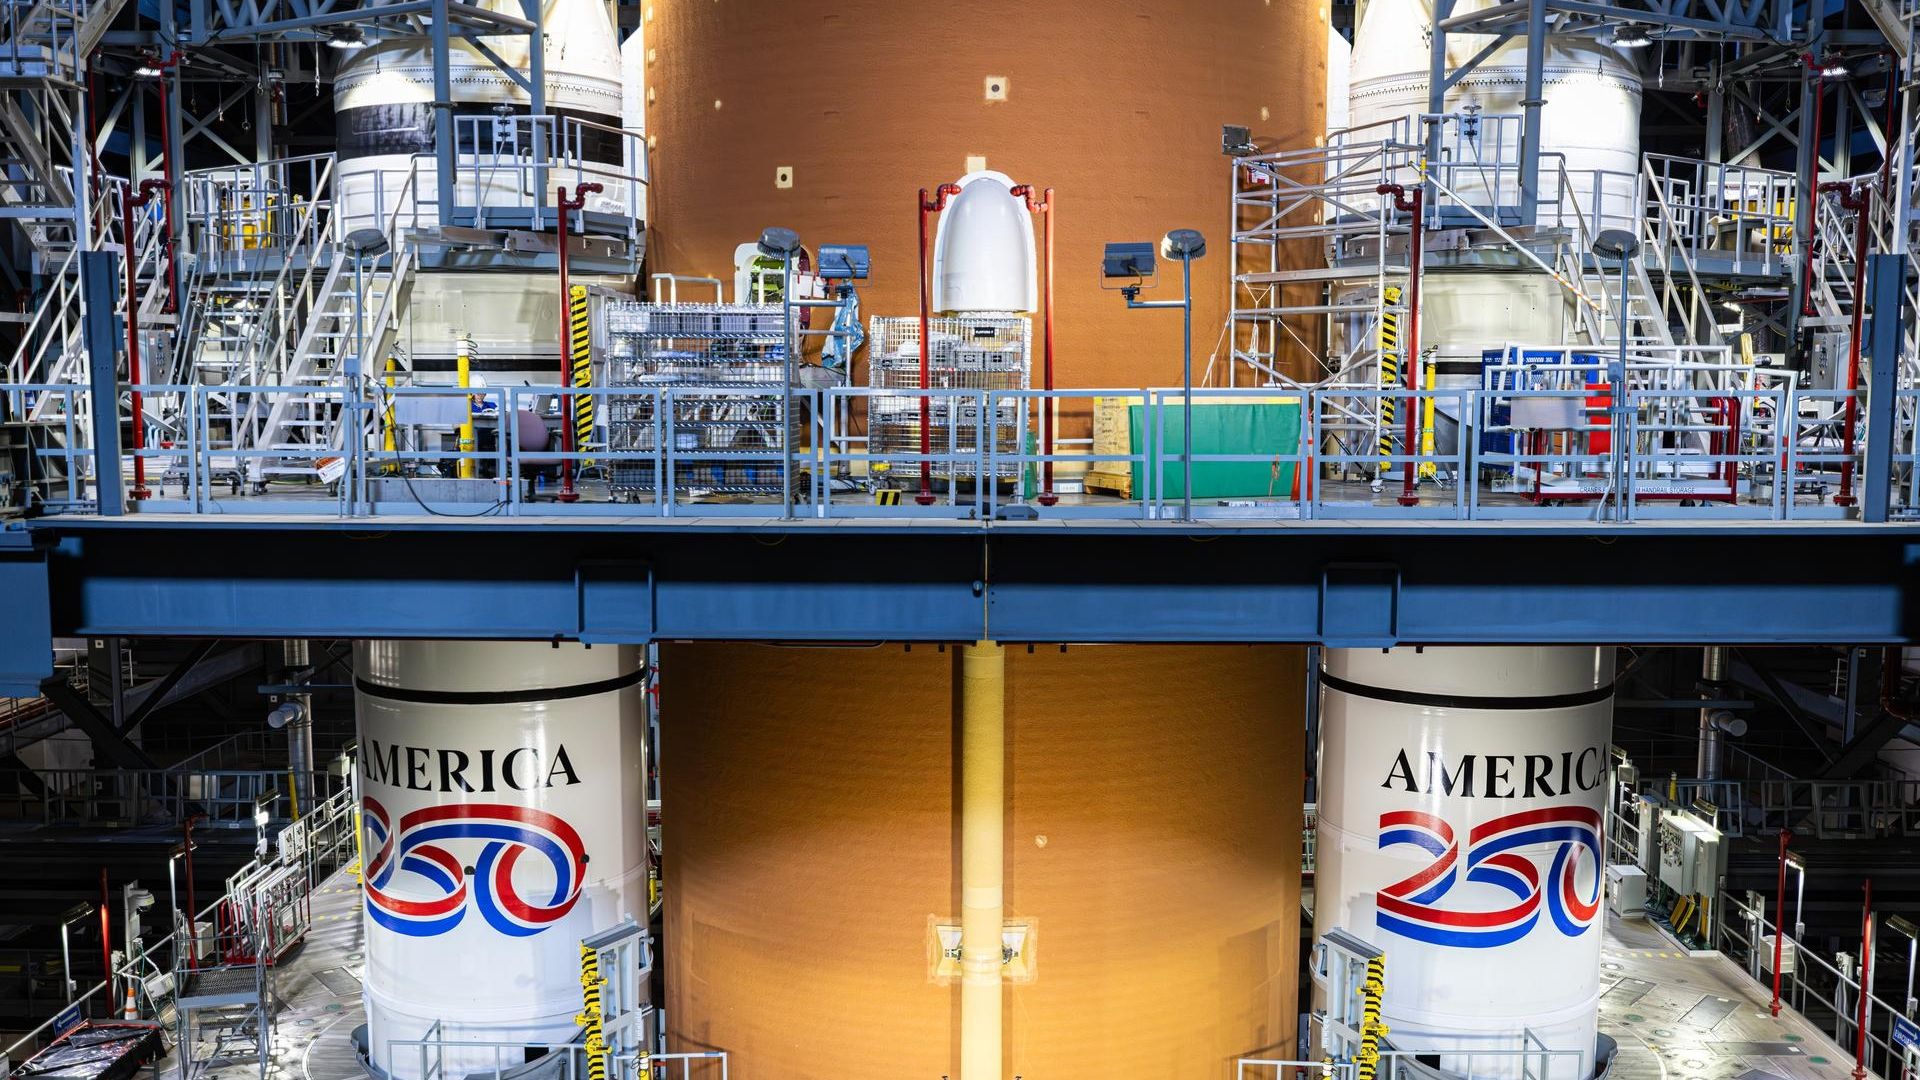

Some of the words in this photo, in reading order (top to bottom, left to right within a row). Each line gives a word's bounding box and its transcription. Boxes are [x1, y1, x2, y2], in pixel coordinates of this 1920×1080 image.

[361, 736, 581, 793] AMERICA
[1380, 743, 1607, 799] AMERICA
[1376, 805, 1604, 948] 250
